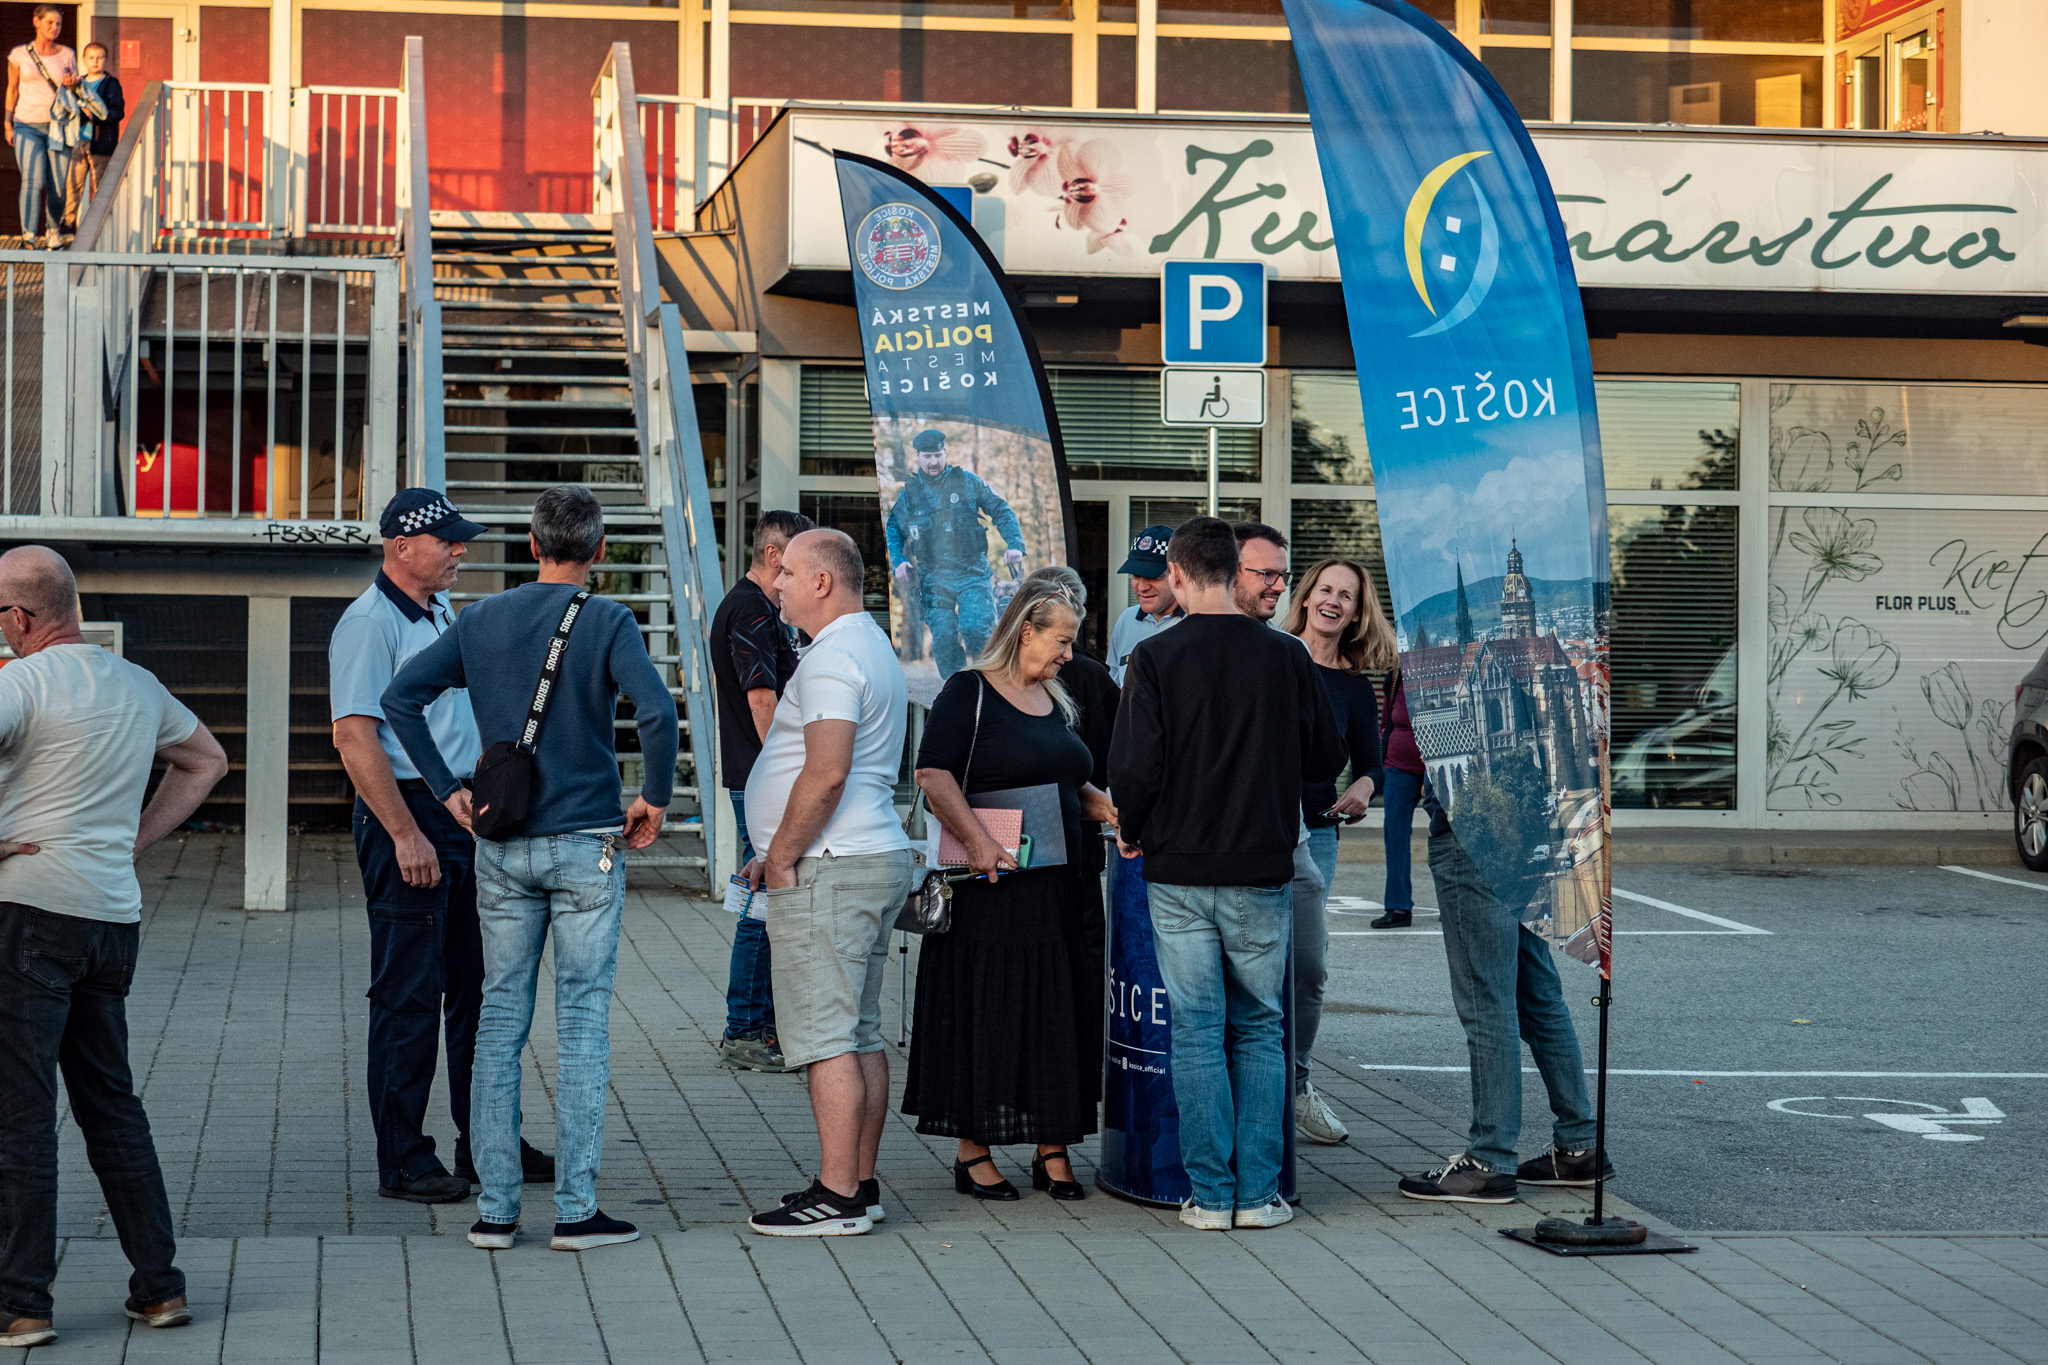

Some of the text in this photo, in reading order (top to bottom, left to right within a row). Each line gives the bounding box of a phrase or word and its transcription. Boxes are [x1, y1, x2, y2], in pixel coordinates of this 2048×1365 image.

[1189, 274, 1243, 350] P
[1876, 595, 1913, 610] FLOR
[1918, 596, 1956, 611] PLUS
[522, 603, 580, 746] SERIOUS SERIOUS SERIOUS SERIO
[1109, 967, 1167, 1026] ŠICE
